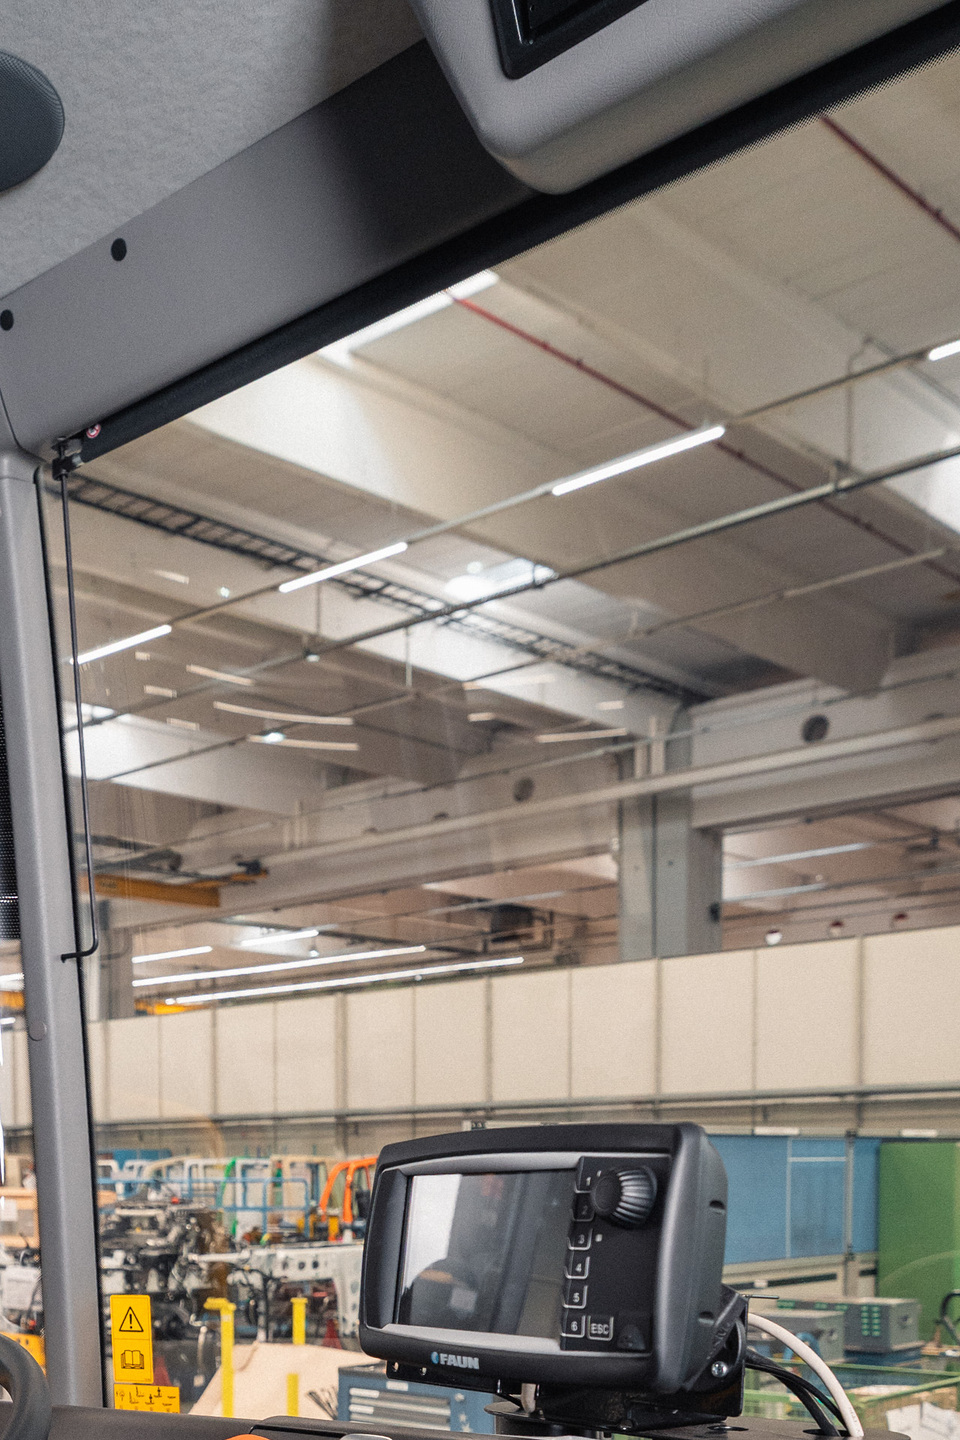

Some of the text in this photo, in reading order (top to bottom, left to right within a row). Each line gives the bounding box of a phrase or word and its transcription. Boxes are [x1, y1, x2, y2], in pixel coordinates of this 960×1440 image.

[577, 1234, 585, 1245] 3
[575, 1263, 582, 1273] 4
[573, 1292, 580, 1303] 5
[570, 1321, 578, 1332] 6
[590, 1322, 610, 1335] ESC
[439, 1353, 480, 1370] FAUN
